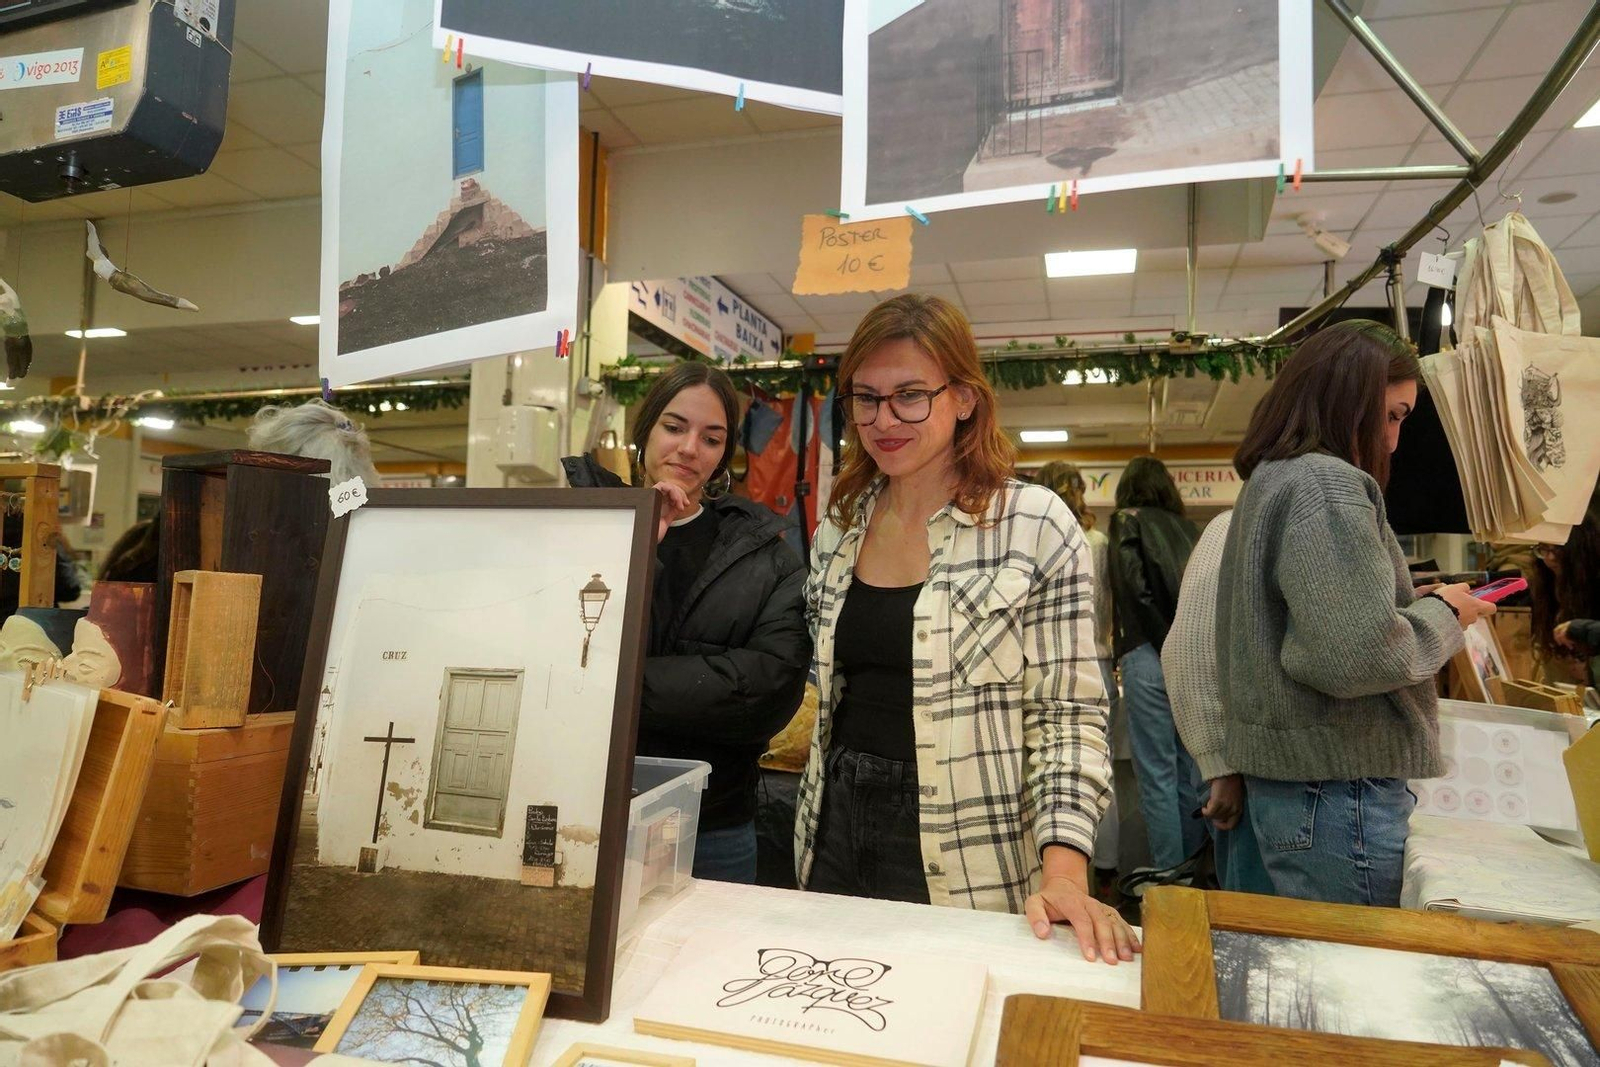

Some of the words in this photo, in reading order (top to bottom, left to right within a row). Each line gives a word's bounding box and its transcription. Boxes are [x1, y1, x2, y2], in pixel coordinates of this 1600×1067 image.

[27, 61, 51, 79] vigo
[53, 60, 79, 75] 2013
[819, 226, 888, 250] POSTER
[837, 253, 861, 274] 10
[867, 254, 885, 272] €
[732, 299, 767, 336] PLANTA
[736, 323, 764, 354] BAIXA
[1178, 487, 1212, 498] CAR
[382, 651, 407, 660] CRUZ
